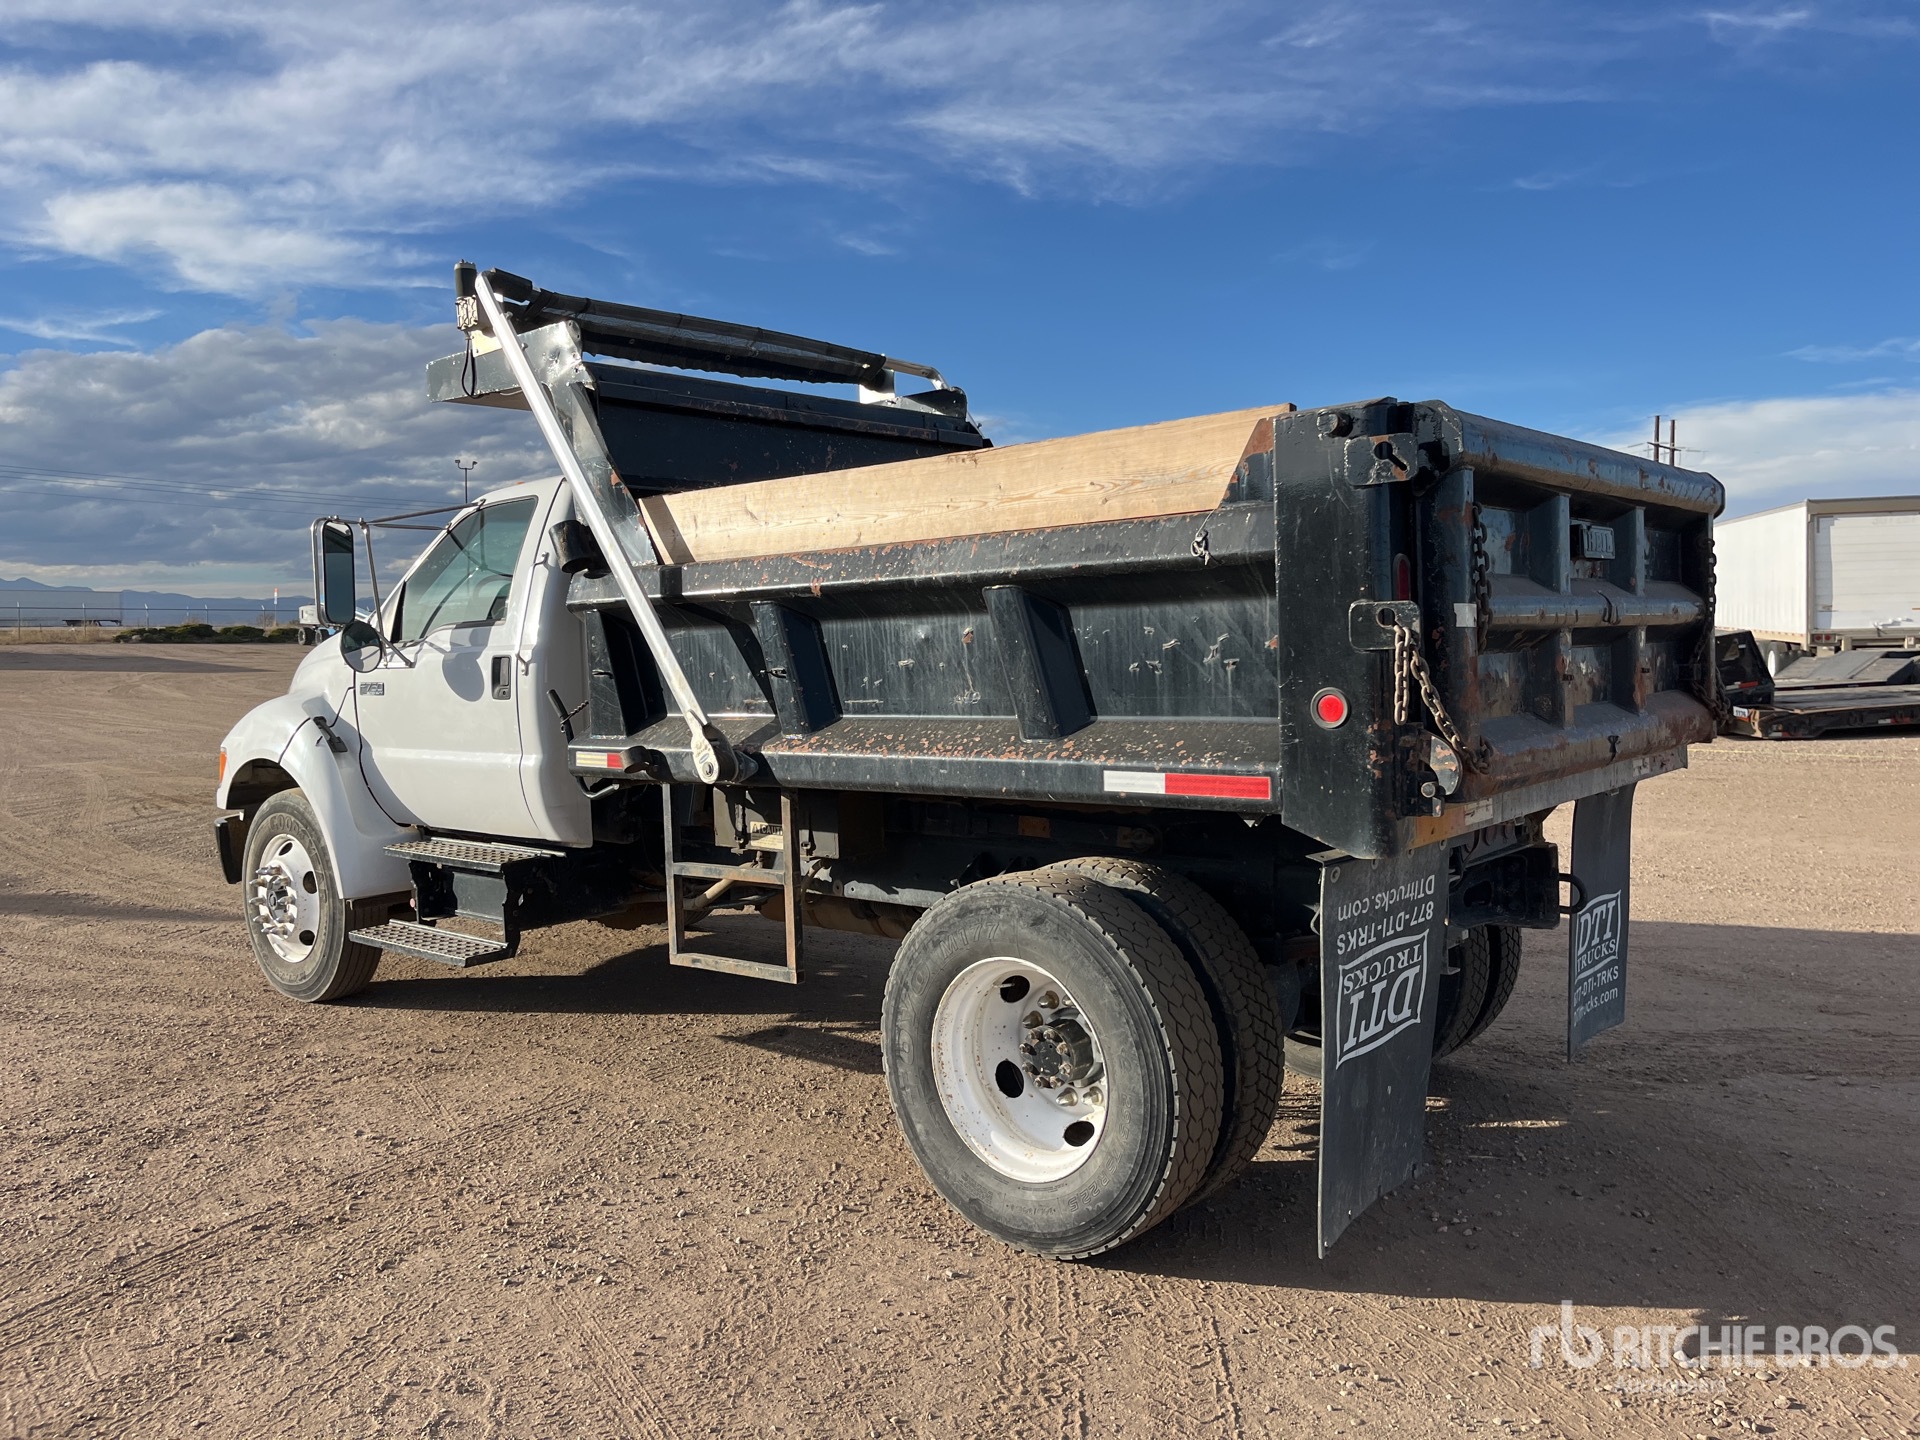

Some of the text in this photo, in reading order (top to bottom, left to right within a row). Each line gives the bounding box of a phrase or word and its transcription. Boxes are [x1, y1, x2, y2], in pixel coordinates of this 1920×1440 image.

[761, 824, 783, 835] CAUTI
[939, 922, 1000, 960] M177
[1336, 901, 1434, 956] 877-DTI-TRKS
[1577, 900, 1616, 957] DTI
[1343, 943, 1422, 995] TRUCKS
[1577, 939, 1616, 973] TRUCKS
[1343, 965, 1421, 1053] DTI
